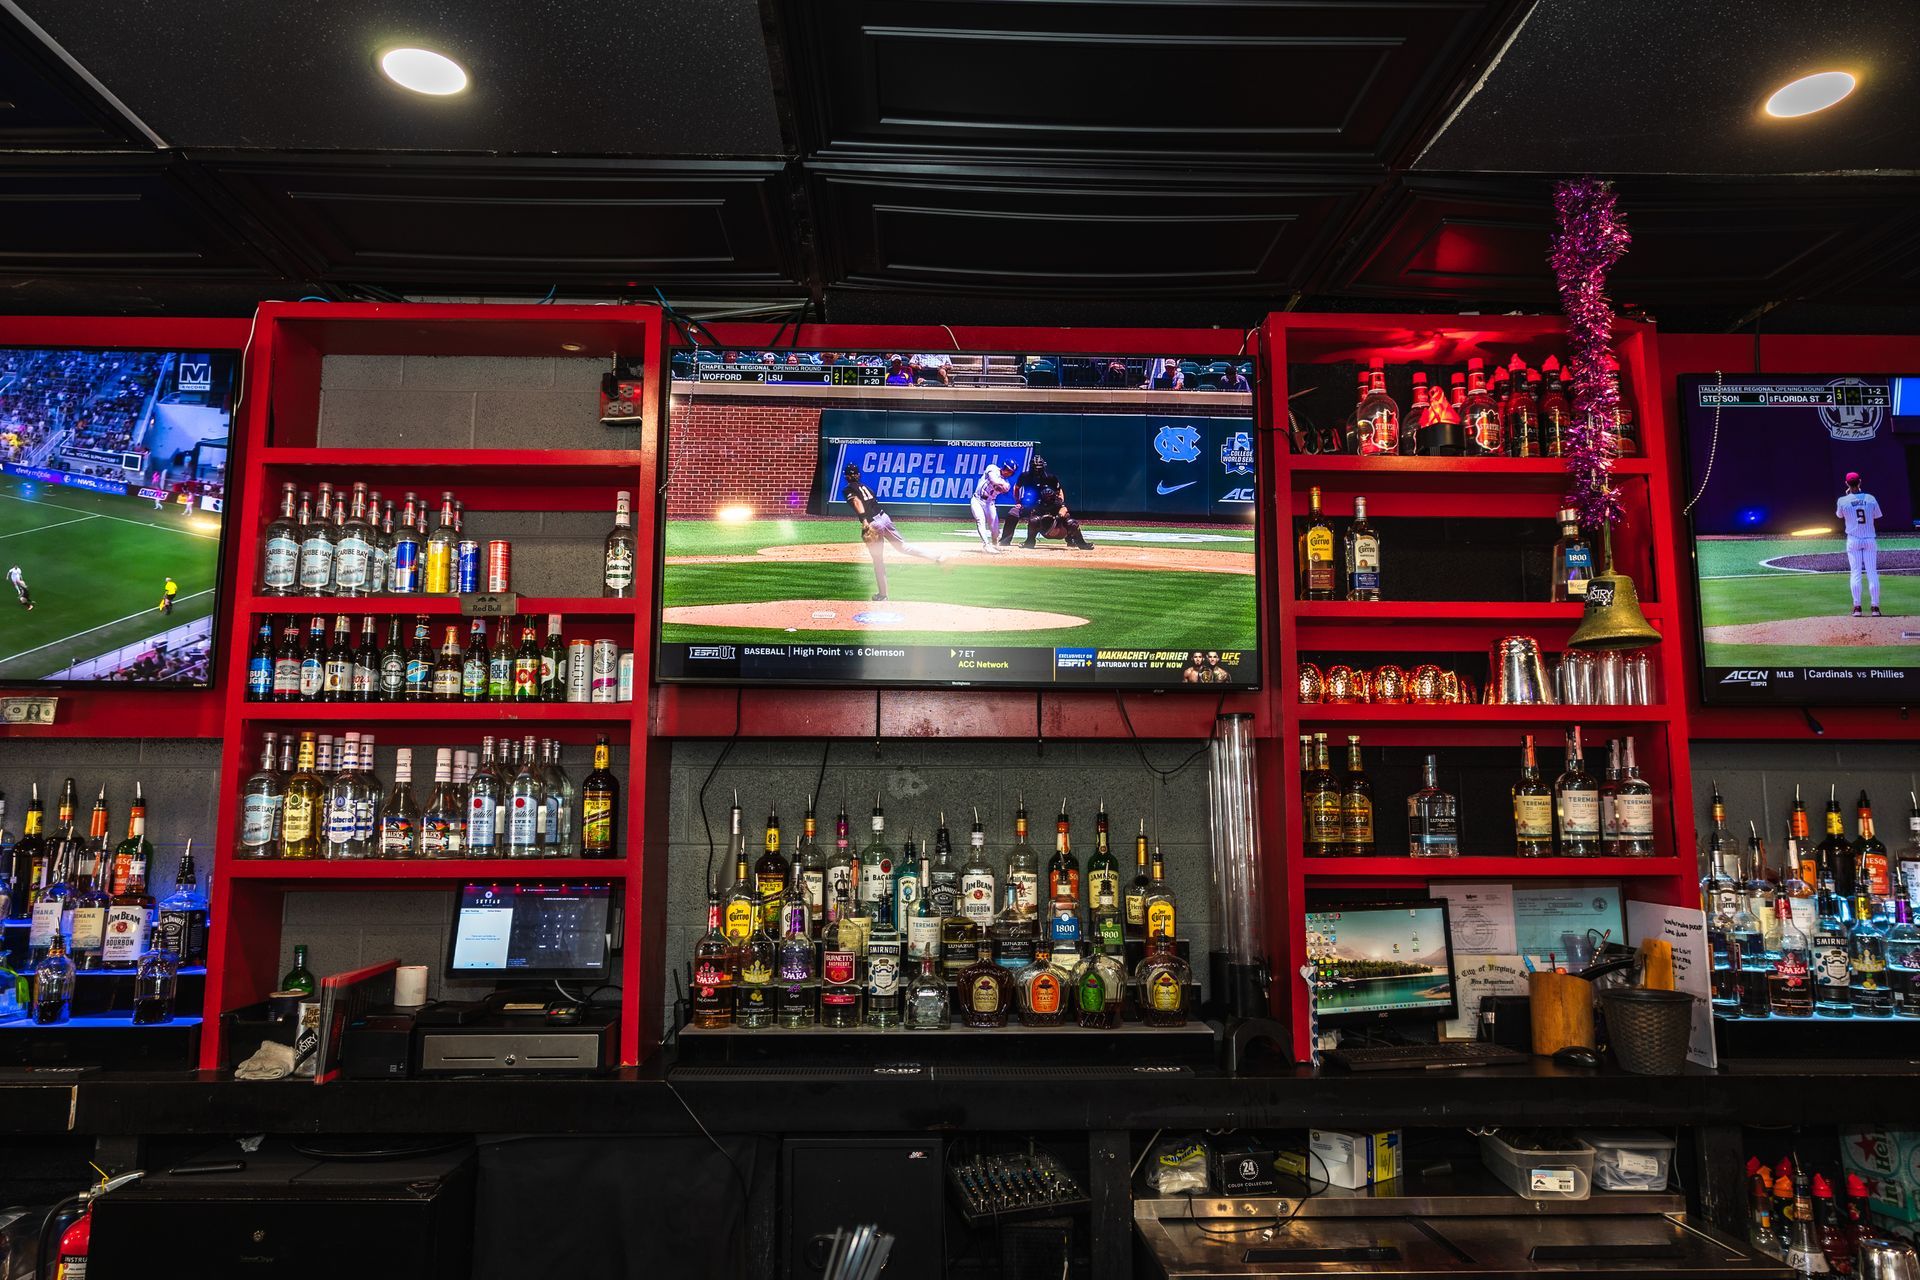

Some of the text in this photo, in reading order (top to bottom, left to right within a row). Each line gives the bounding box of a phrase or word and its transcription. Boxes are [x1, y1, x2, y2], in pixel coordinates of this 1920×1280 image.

[702, 373, 742, 381] WOFFORD
[1759, 394, 1765, 403] 0
[1826, 395, 1832, 403] 2
[862, 452, 946, 474] CHAPEL
[877, 477, 977, 499] REGIONA
[1222, 488, 1254, 499] AC
[1856, 509, 1866, 524] 9
[286, 549, 298, 558] BAY
[356, 549, 368, 558] BAY
[744, 647, 785, 655] BASEBALL
[793, 648, 814, 657] High
[816, 648, 841, 656] Point
[865, 649, 905, 657] Clemson
[965, 650, 975, 658] ET
[1097, 651, 1149, 660] MAKHACHEV
[1155, 652, 1188, 660] POIRIER
[1222, 652, 1241, 660] UFC
[958, 660, 1009, 669] ACC Network
[329, 665, 344, 674] Lite
[1809, 669, 1853, 678] Cardinals
[1870, 670, 1904, 678] Phillies
[434, 673, 455, 681] Modelo
[492, 671, 508, 679] ROCK
[1725, 671, 1768, 679] ACCN
[965, 880, 993, 892] JIM BEAM
[108, 911, 141, 925] JIM BEAM
[729, 913, 749, 921] Cuervo
[1488, 964, 1516, 974] Virginia
[1778, 964, 1806, 974] TAAKA
[783, 971, 807, 979] TAAKA
[1242, 1162, 1255, 1172] 24
